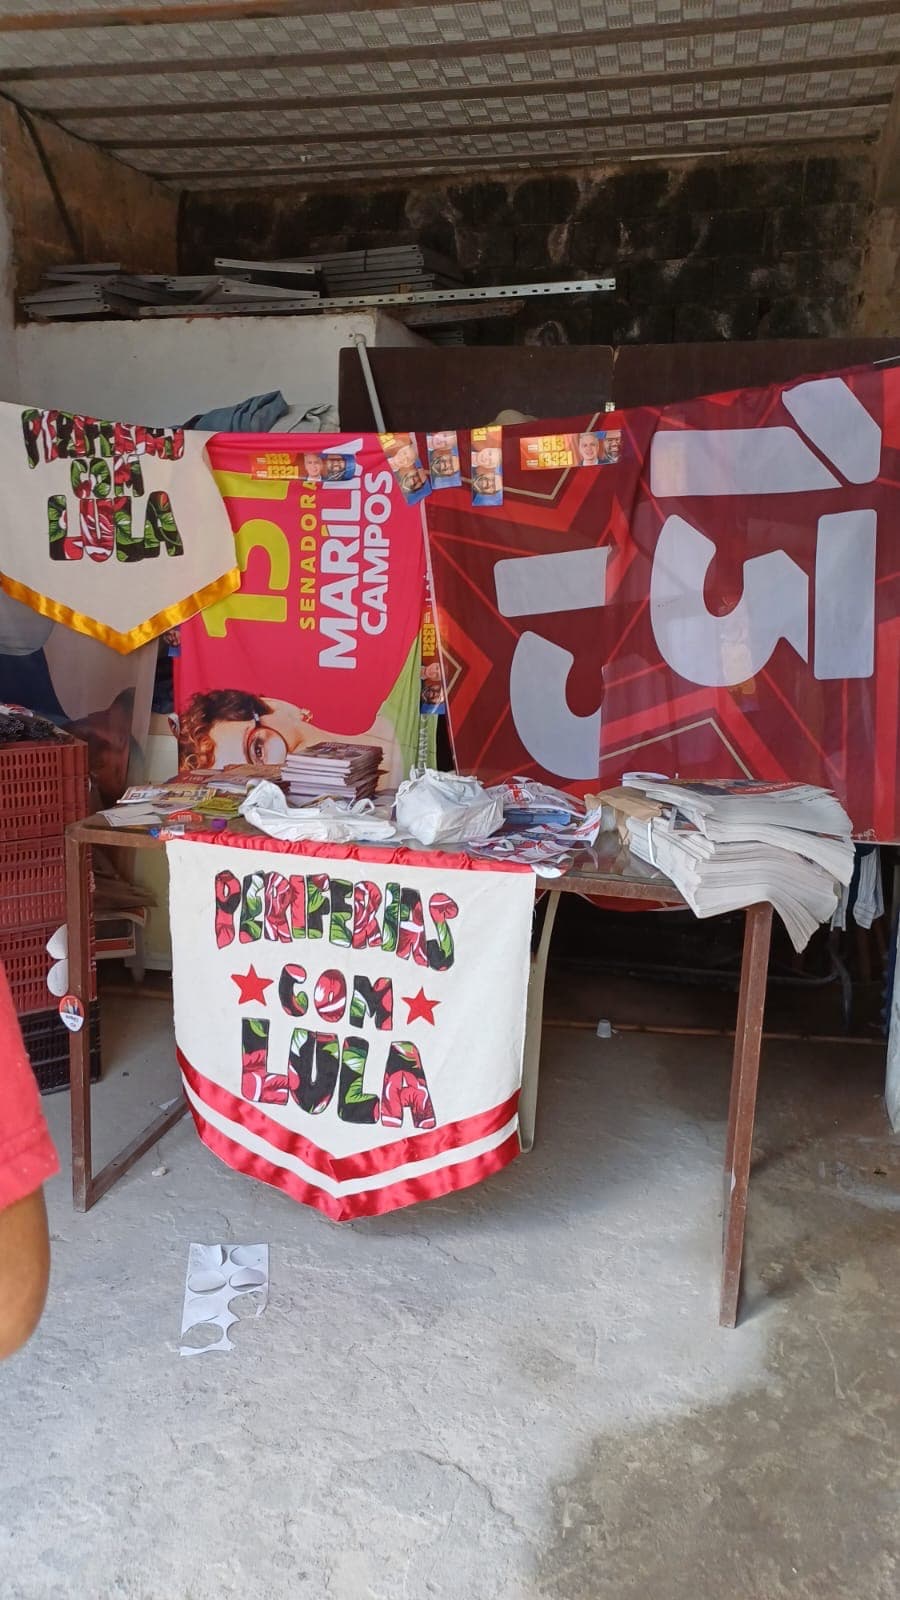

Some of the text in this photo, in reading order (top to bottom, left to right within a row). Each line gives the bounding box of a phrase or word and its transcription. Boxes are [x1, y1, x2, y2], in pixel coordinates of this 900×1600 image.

[70, 457, 145, 498] COM
[47, 491, 184, 562] LULA
[361, 470, 393, 635] CAMPOS
[214, 869, 459, 971] PERIFERIAS
[278, 963, 393, 1031] COM
[241, 1017, 436, 1129] LULA
